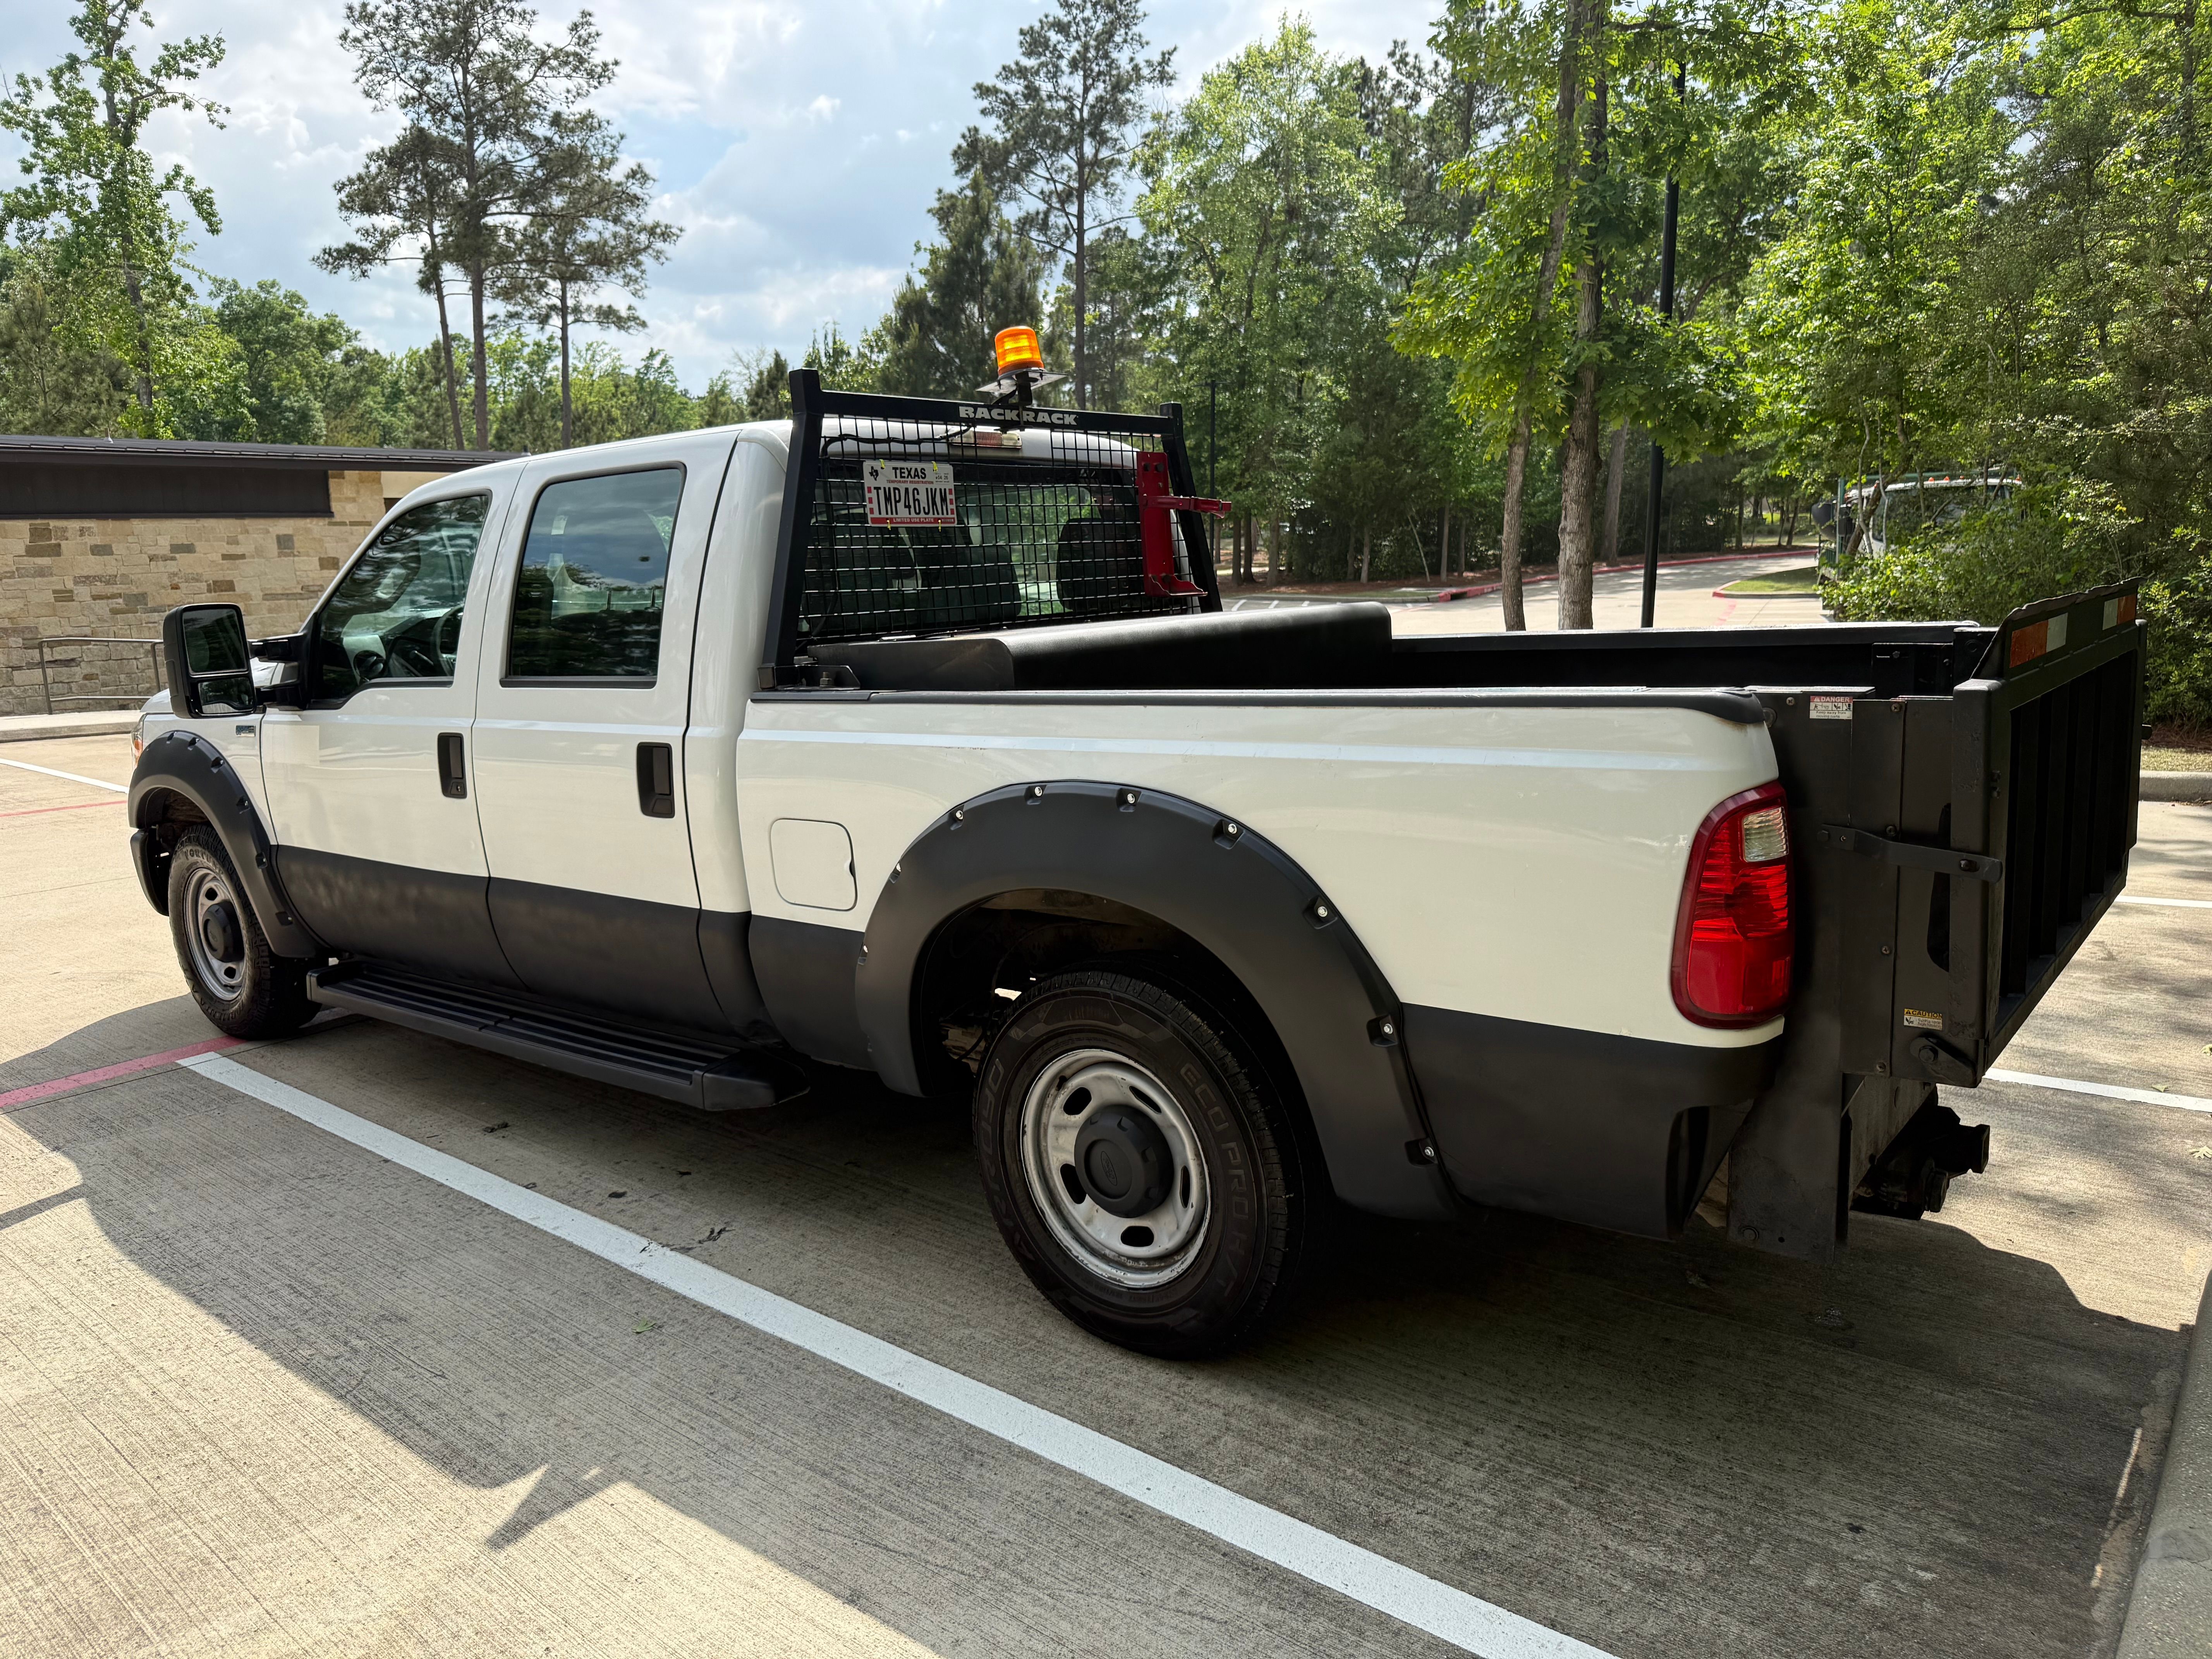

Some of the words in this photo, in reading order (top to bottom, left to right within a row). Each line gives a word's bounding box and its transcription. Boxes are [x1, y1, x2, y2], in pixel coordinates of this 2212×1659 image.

[959, 406, 1077, 425] BACKRACK
[892, 467, 927, 479] TEXAS
[873, 486, 949, 515] TMP46JKM
[1912, 1010, 1942, 1018] CAUTION
[1180, 1064, 1230, 1132] ECO
[1221, 1141, 1249, 1220] PRO
